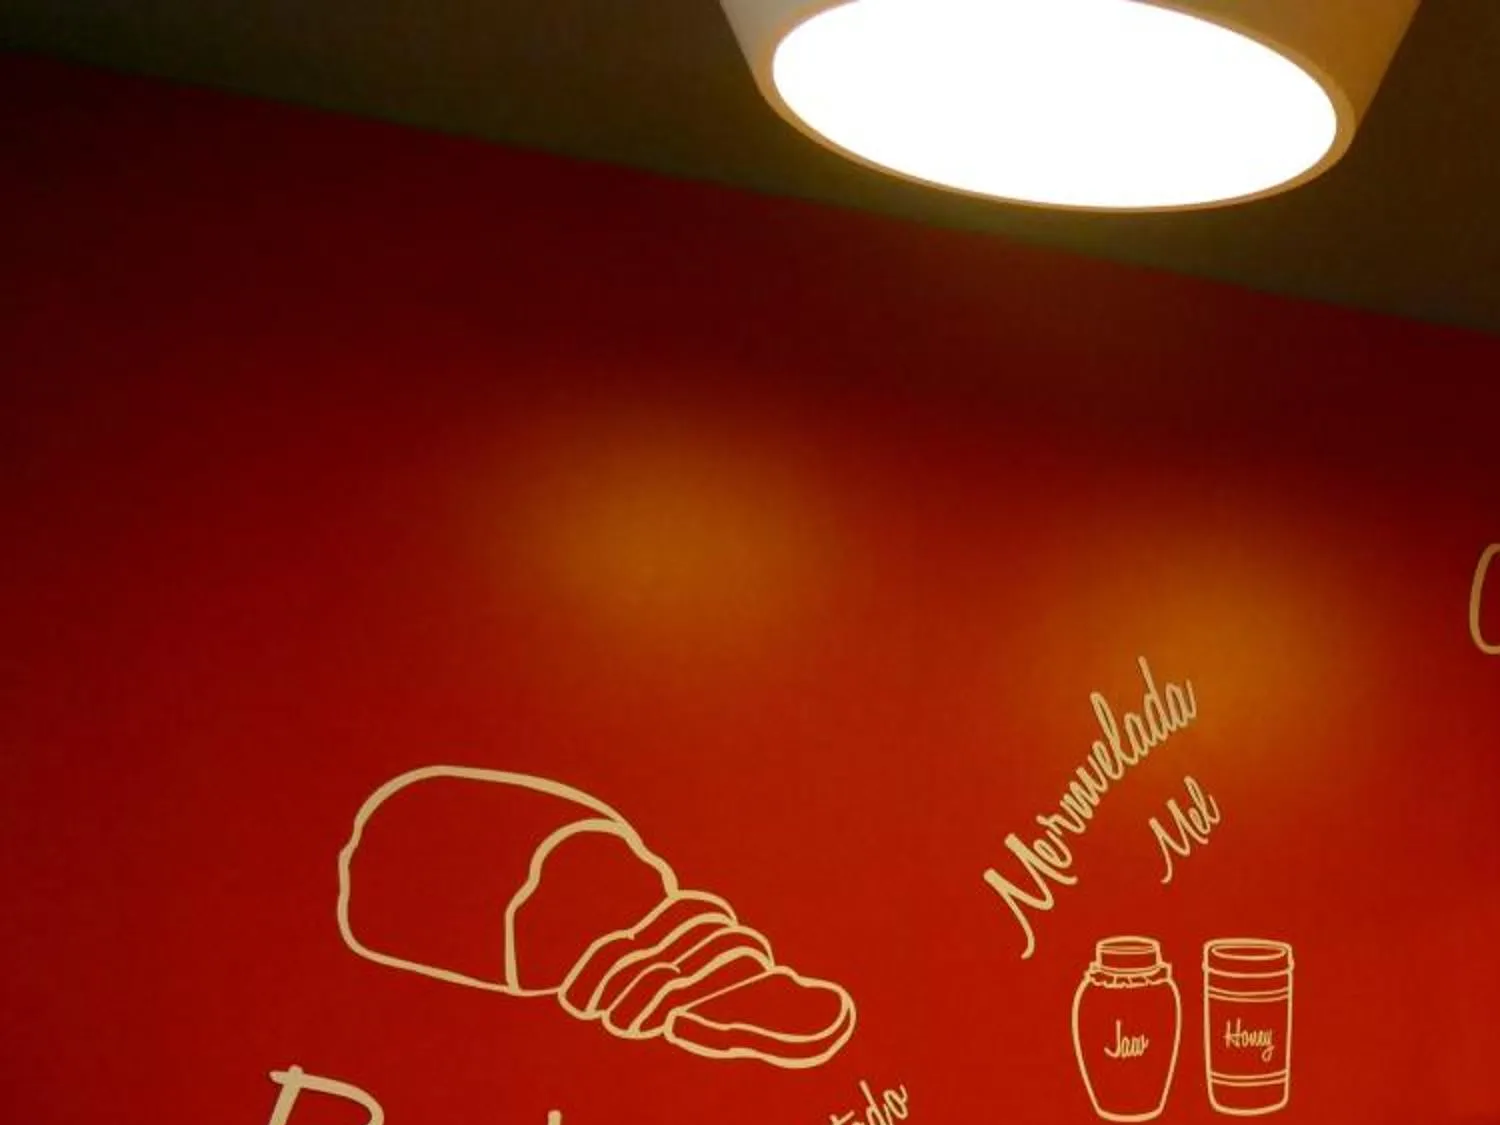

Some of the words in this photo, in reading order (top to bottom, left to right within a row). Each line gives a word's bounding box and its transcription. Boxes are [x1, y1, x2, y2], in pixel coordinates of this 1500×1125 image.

[982, 655, 1198, 960] Mermelada
[1148, 775, 1222, 885] Mel
[1103, 1019, 1150, 1060] Jam
[1222, 1017, 1276, 1063] Honey
